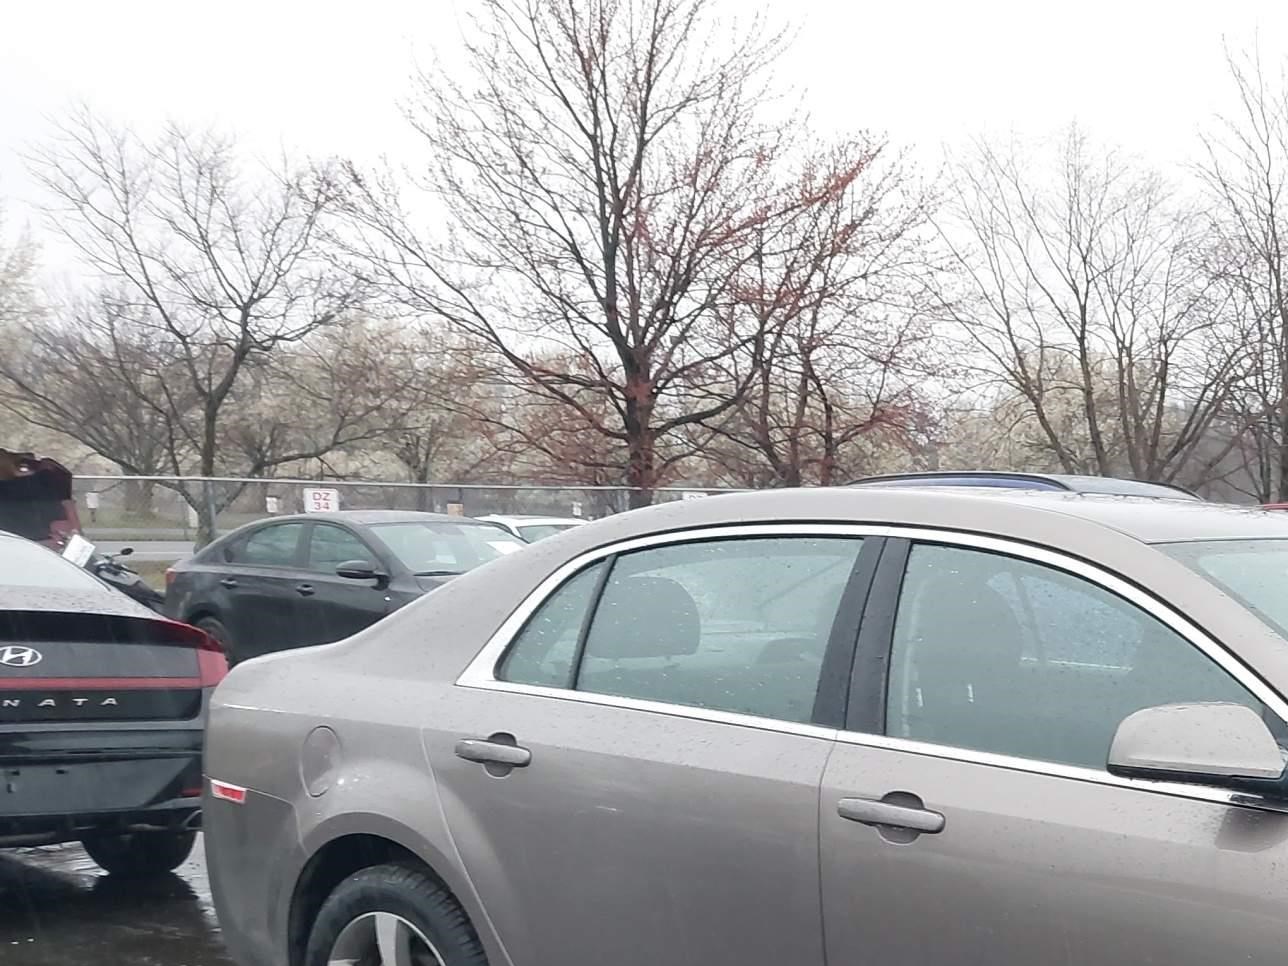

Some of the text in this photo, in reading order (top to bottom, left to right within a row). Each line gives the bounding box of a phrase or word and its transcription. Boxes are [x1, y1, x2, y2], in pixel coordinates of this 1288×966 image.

[312, 492, 331, 501] DZ
[314, 502, 330, 510] 34
[3, 697, 118, 707] NATA
